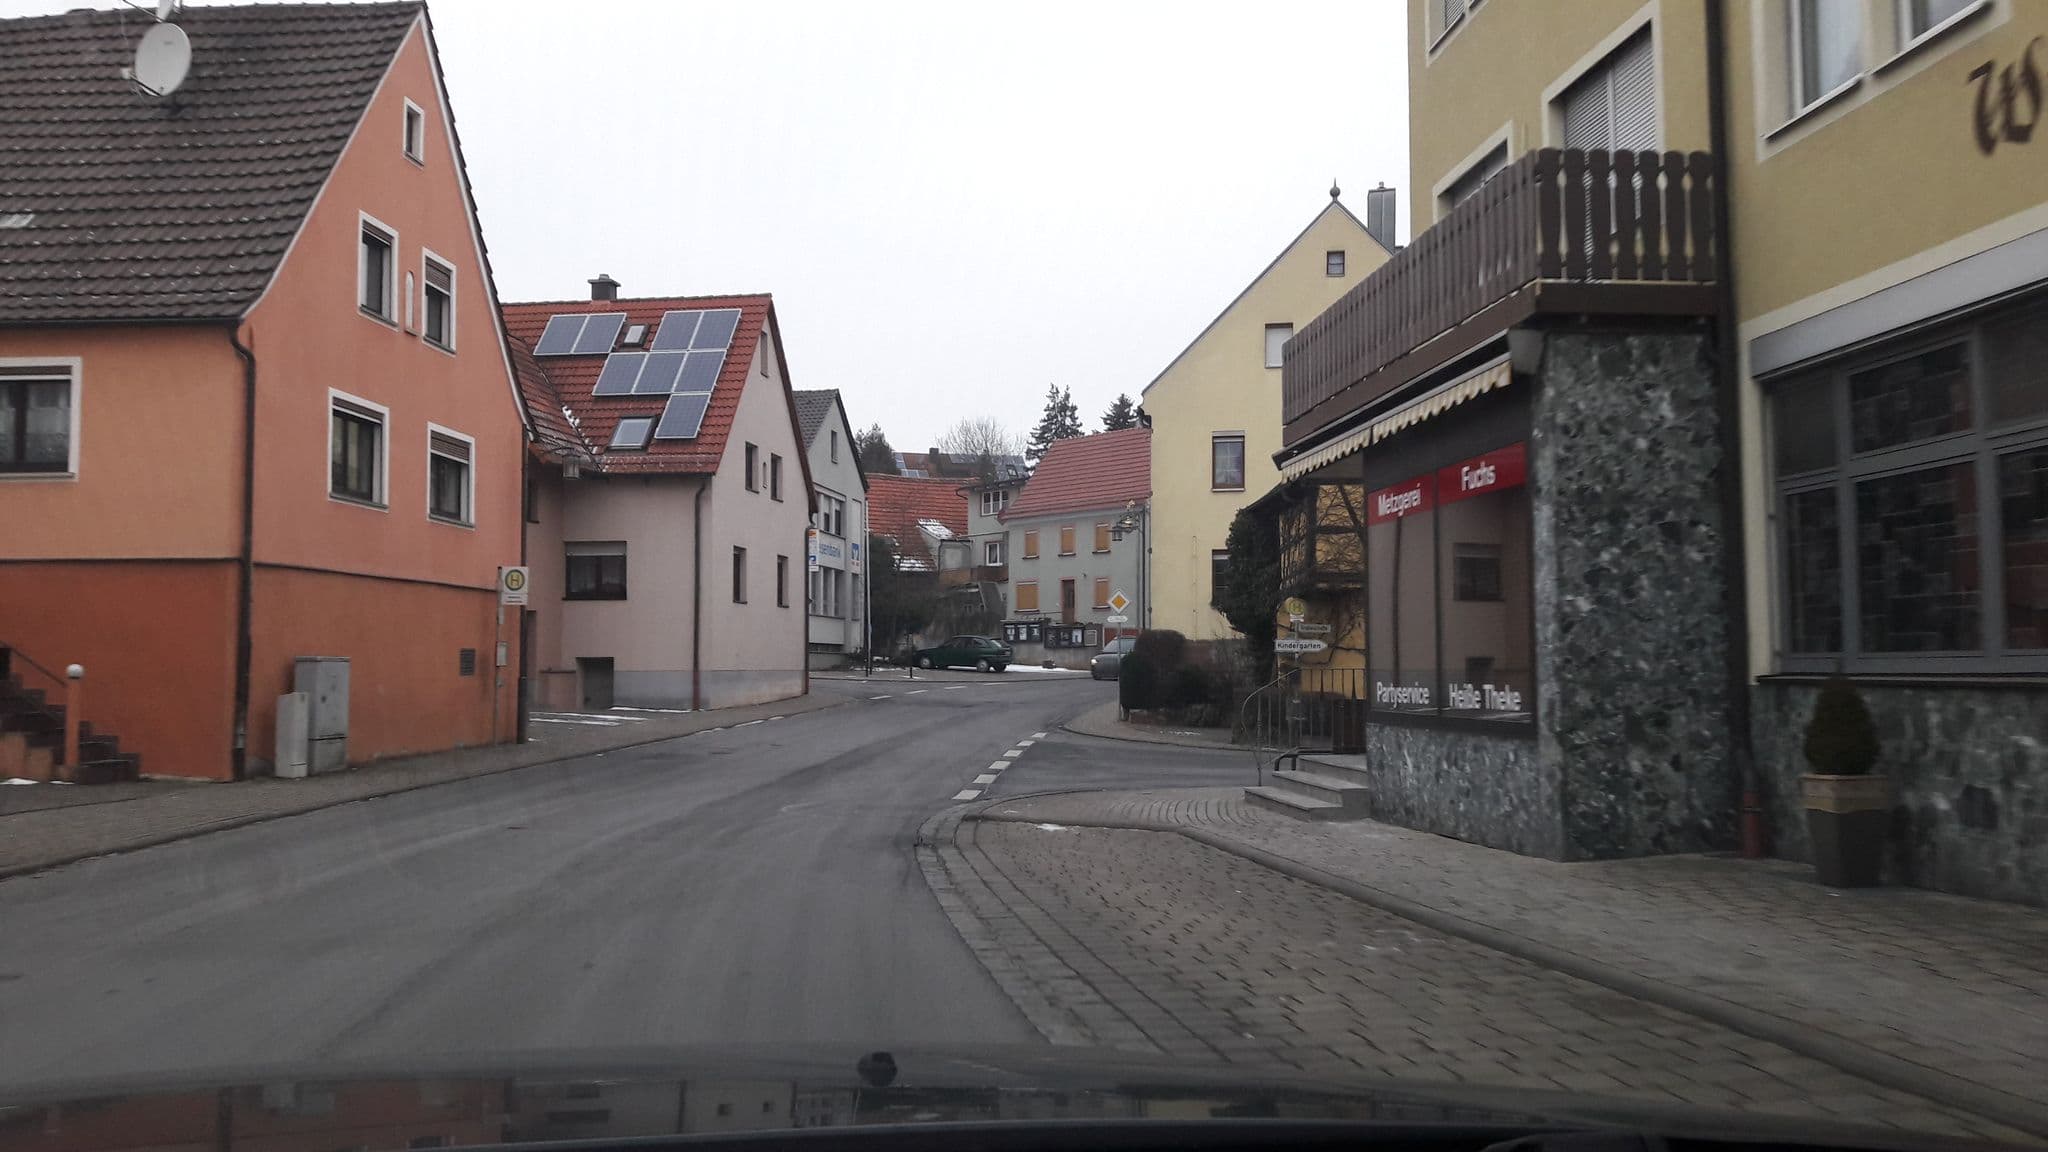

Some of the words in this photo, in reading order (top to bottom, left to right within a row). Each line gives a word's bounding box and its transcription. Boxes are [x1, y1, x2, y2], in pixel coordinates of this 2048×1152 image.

[1461, 461, 1496, 491] Fuchs
[1378, 482, 1421, 517] Metzgerei
[1277, 642, 1321, 650] Kindergarten
[1377, 681, 1430, 708] Partyservice
[1449, 683, 1481, 709] Heiße
[1482, 684, 1521, 711] Theke
